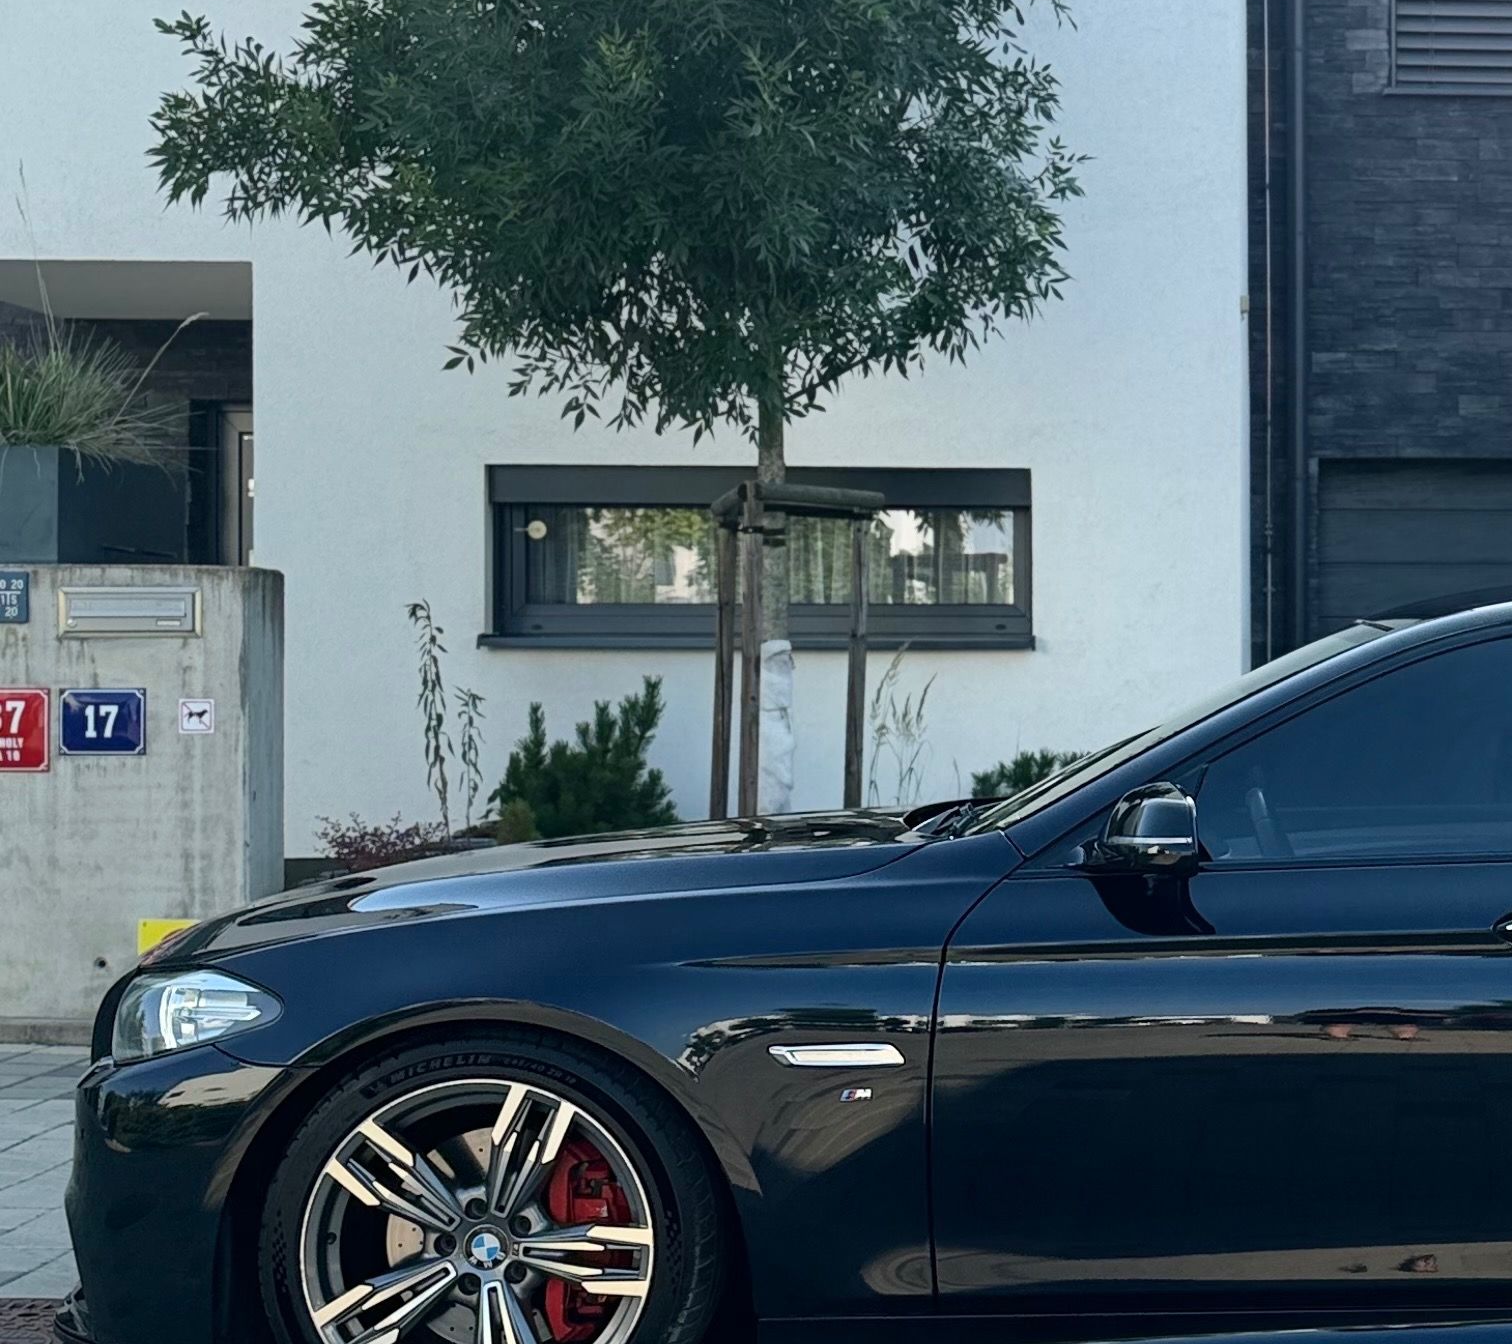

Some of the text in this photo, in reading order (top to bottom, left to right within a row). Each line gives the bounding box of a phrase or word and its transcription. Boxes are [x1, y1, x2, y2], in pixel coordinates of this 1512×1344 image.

[10, 579, 24, 590] 20
[0, 700, 26, 734] 7
[84, 704, 119, 739] 17
[388, 1055, 491, 1084] MICHELIN
